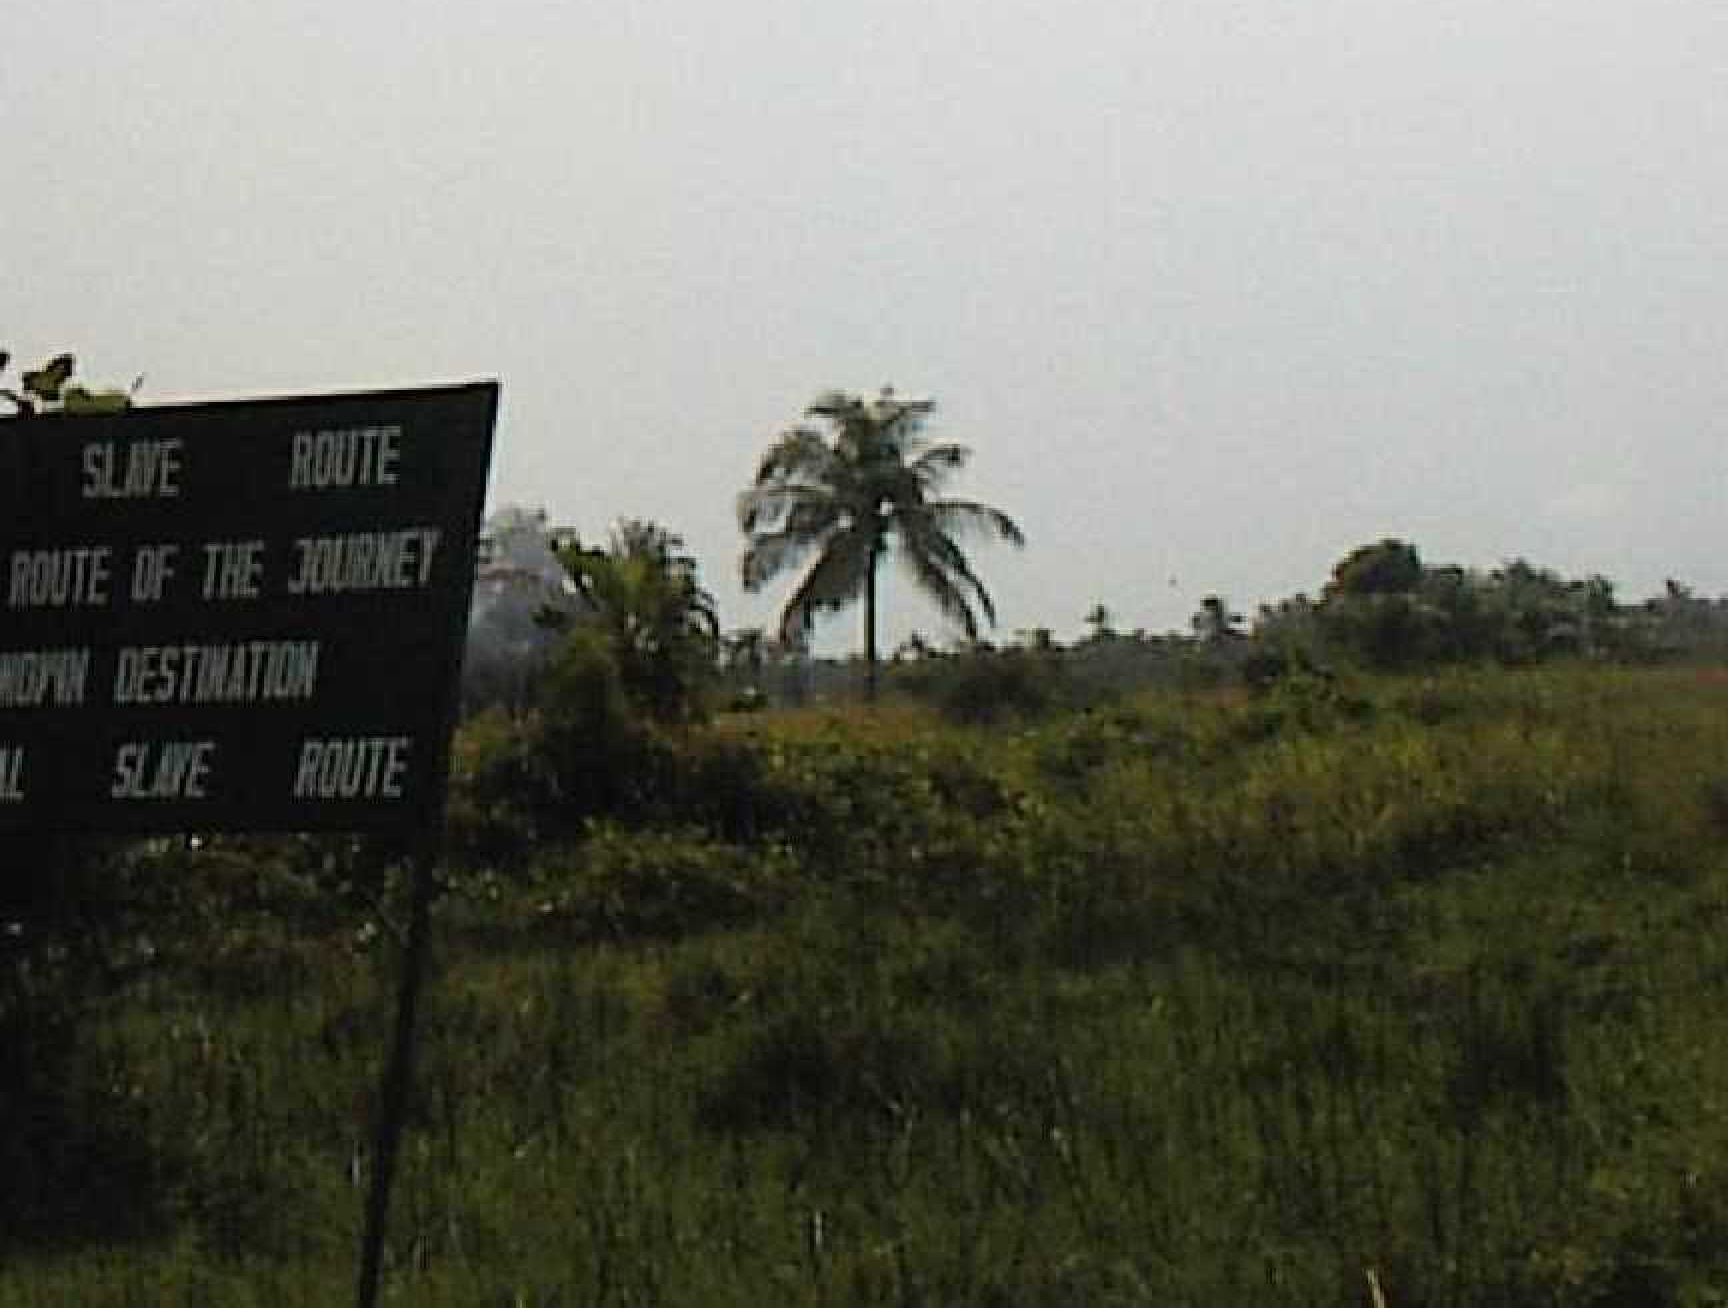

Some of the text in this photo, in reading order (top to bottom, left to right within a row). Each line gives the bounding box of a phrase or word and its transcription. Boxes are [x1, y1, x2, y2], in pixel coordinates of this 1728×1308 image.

[82, 438, 184, 498] SLAVE
[290, 425, 402, 488] ROUTE
[9, 546, 112, 607] ROUTE
[132, 545, 177, 601] OF
[203, 541, 264, 598] THE
[288, 528, 442, 593] JOURNEY
[114, 640, 319, 703] DESTINATION
[112, 742, 216, 800] SLAVE
[292, 737, 409, 799] ROUTE
